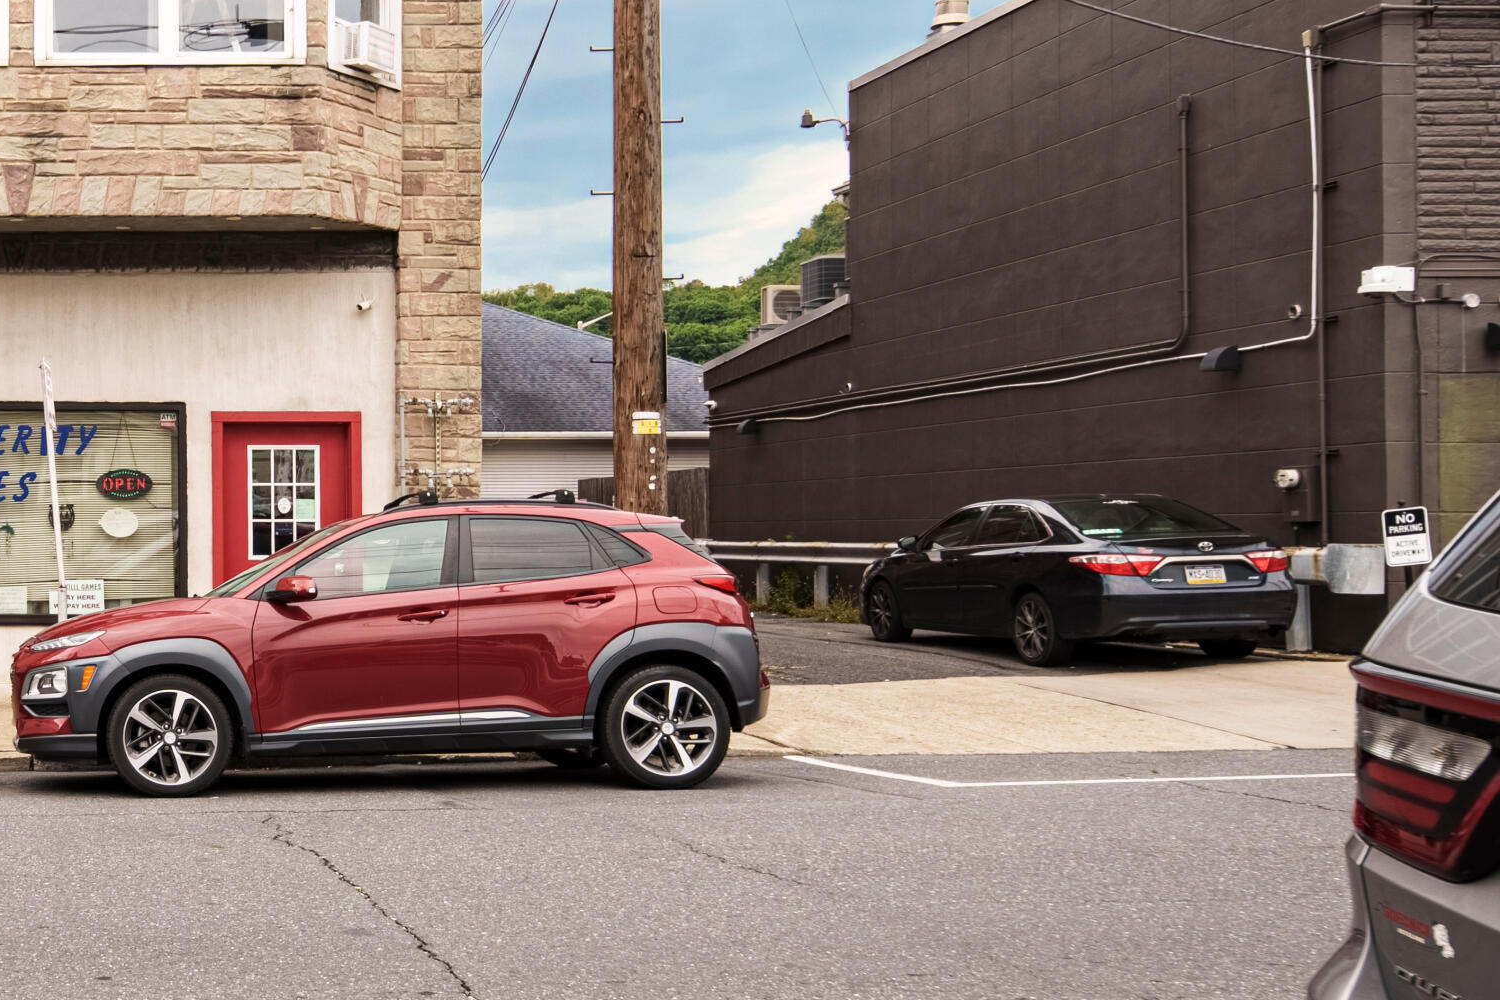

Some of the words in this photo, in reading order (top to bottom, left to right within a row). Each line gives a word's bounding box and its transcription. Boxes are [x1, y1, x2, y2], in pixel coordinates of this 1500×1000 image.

[102, 477, 146, 491] OPEN
[1395, 513, 1416, 525] NO
[1388, 523, 1424, 535] PARKING
[81, 583, 102, 591] GAMES
